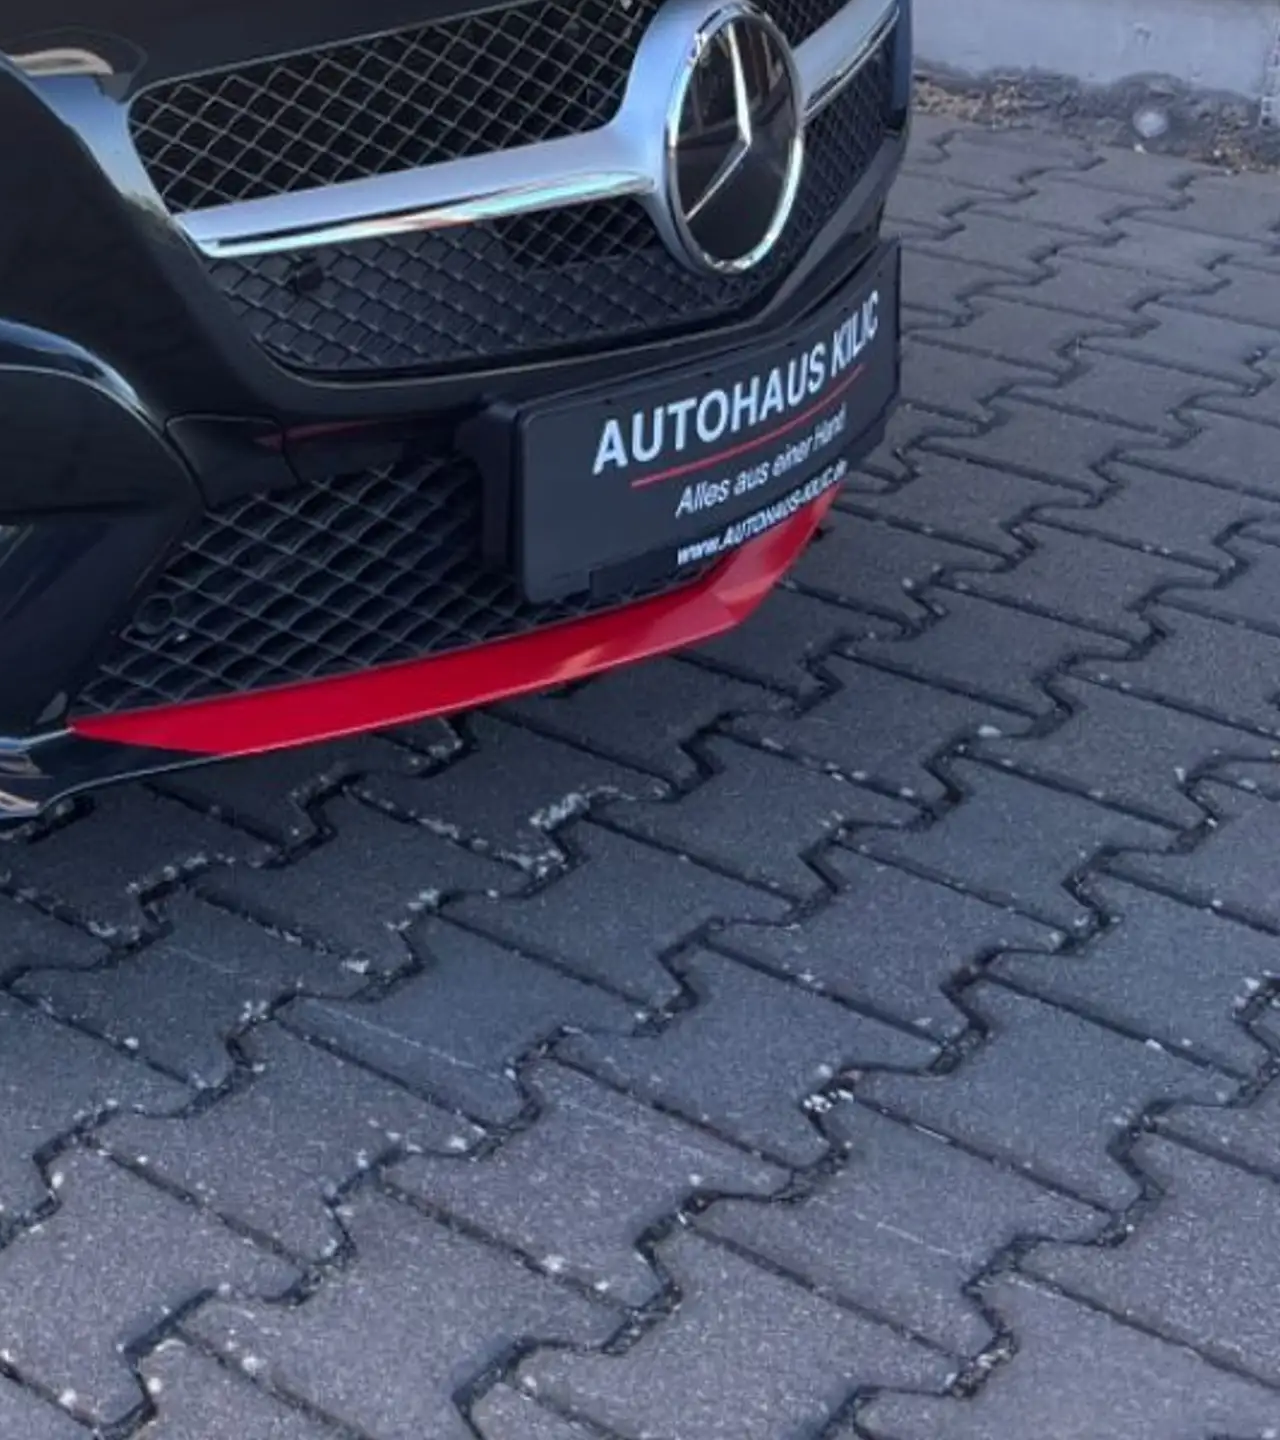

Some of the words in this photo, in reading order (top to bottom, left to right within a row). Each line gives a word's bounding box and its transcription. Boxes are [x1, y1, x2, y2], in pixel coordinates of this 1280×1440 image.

[592, 342, 827, 475] AUTOHAUS
[831, 289, 879, 377] KILIC
[675, 479, 731, 519] Alles
[734, 461, 770, 496] aus
[772, 435, 813, 477] einer
